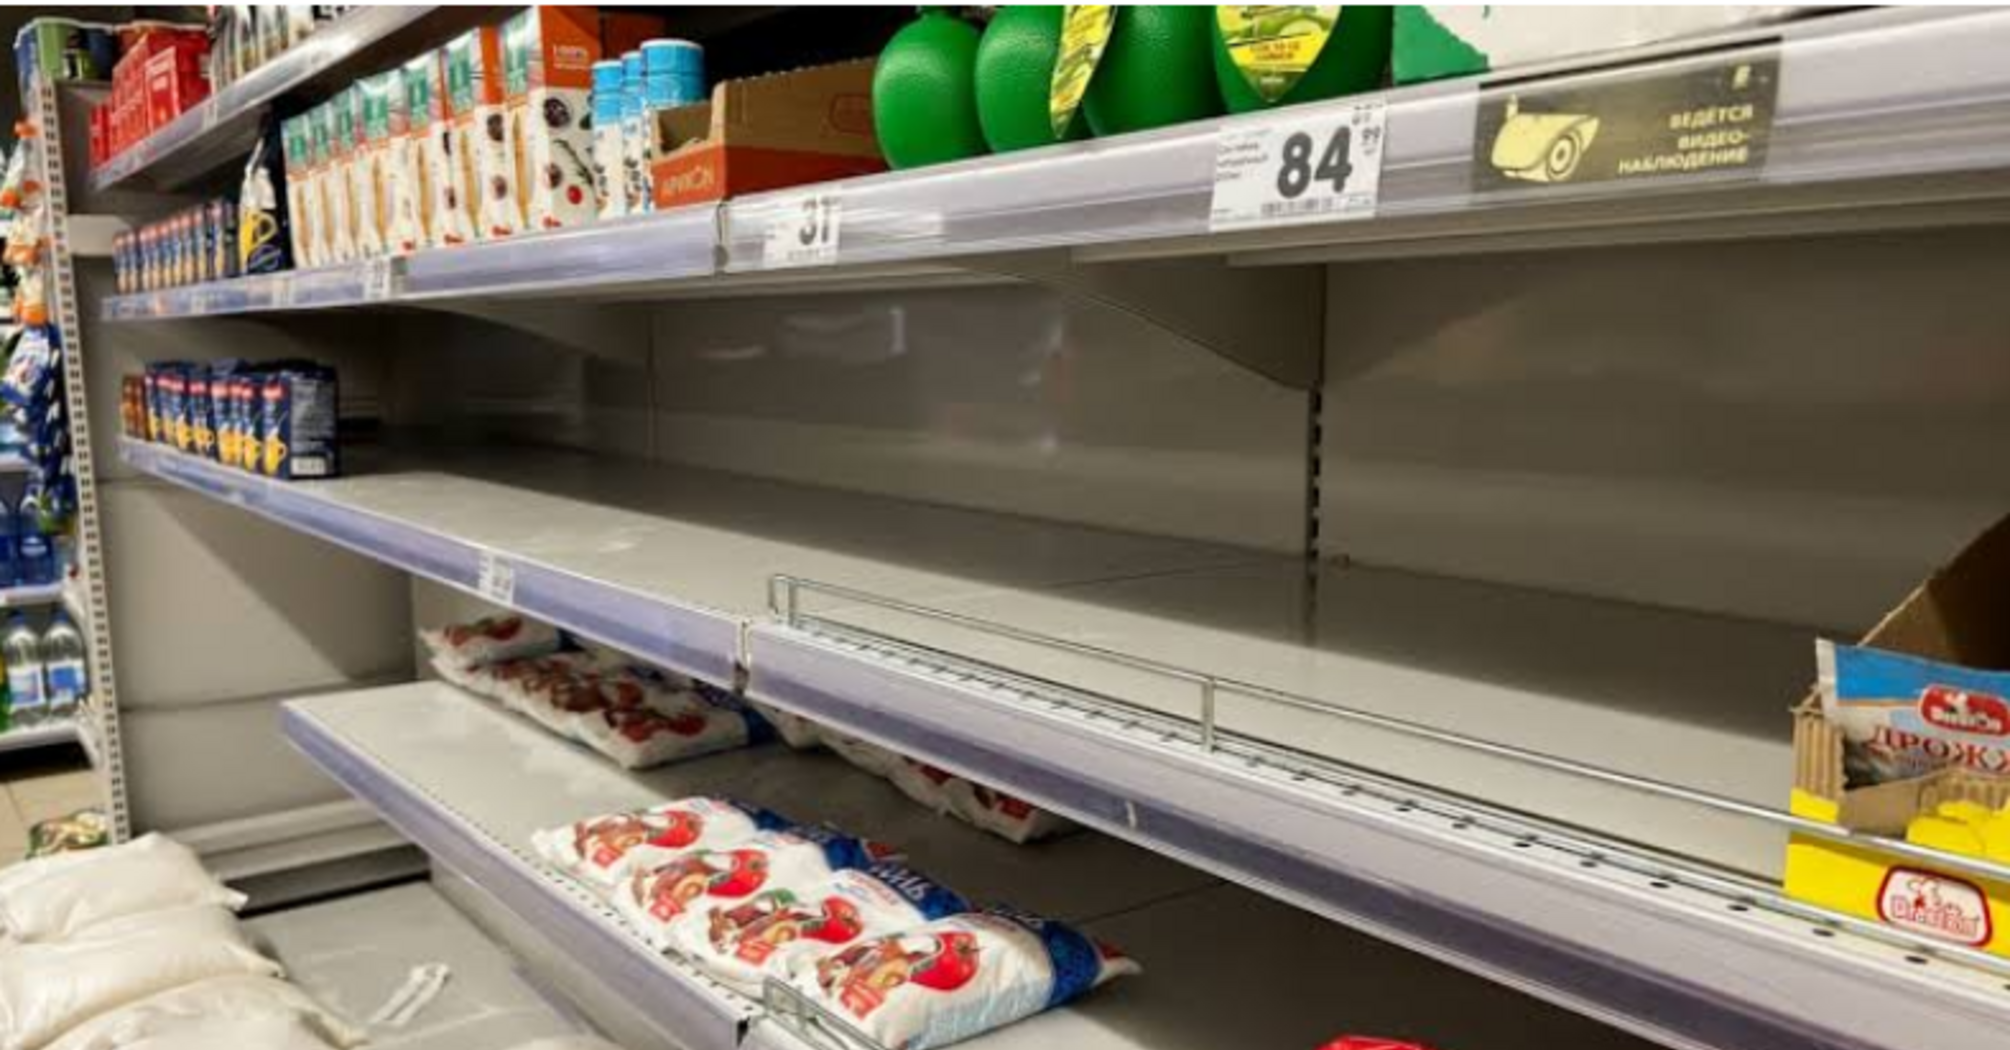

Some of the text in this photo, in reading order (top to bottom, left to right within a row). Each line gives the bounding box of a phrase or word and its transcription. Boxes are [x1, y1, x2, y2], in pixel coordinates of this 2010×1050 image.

[1277, 125, 1352, 199] 84
[1618, 147, 1749, 174] НАБЛЮДЕНИЕ
[1867, 726, 2010, 771] ДРОЖ
